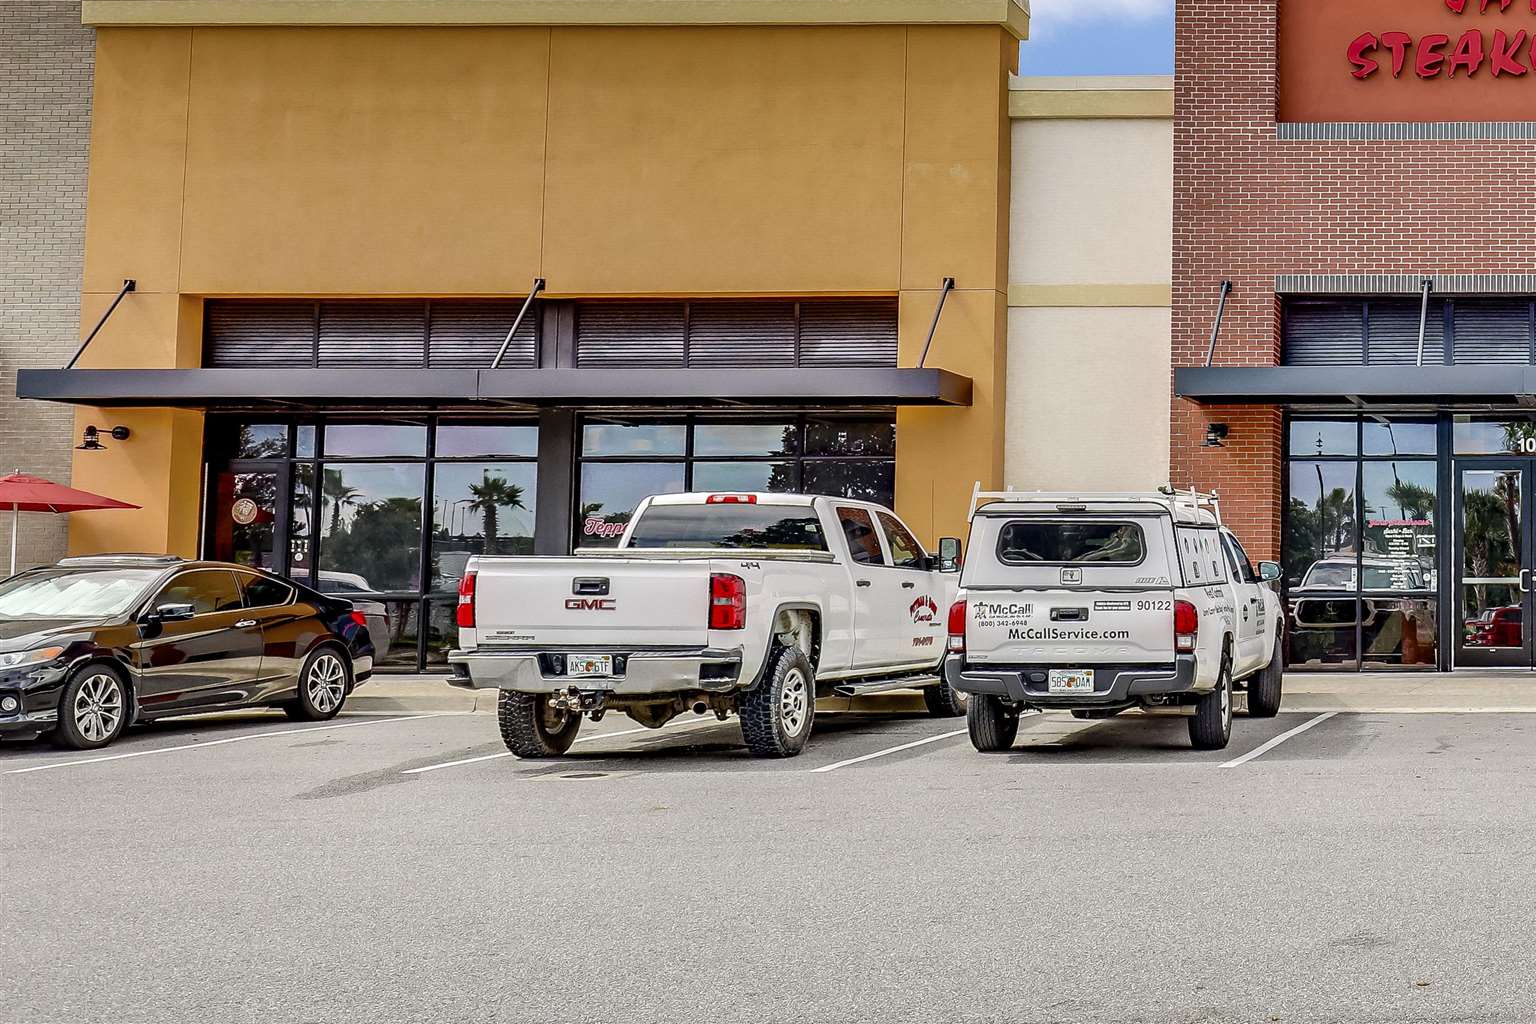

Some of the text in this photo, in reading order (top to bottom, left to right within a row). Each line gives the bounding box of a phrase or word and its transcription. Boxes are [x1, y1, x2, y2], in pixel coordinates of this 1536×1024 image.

[584, 517, 629, 537] Tepp
[565, 599, 616, 610] GMC
[989, 604, 1031, 614] McCall
[1137, 601, 1171, 610] 90122
[1008, 628, 1129, 639] McCallService.com
